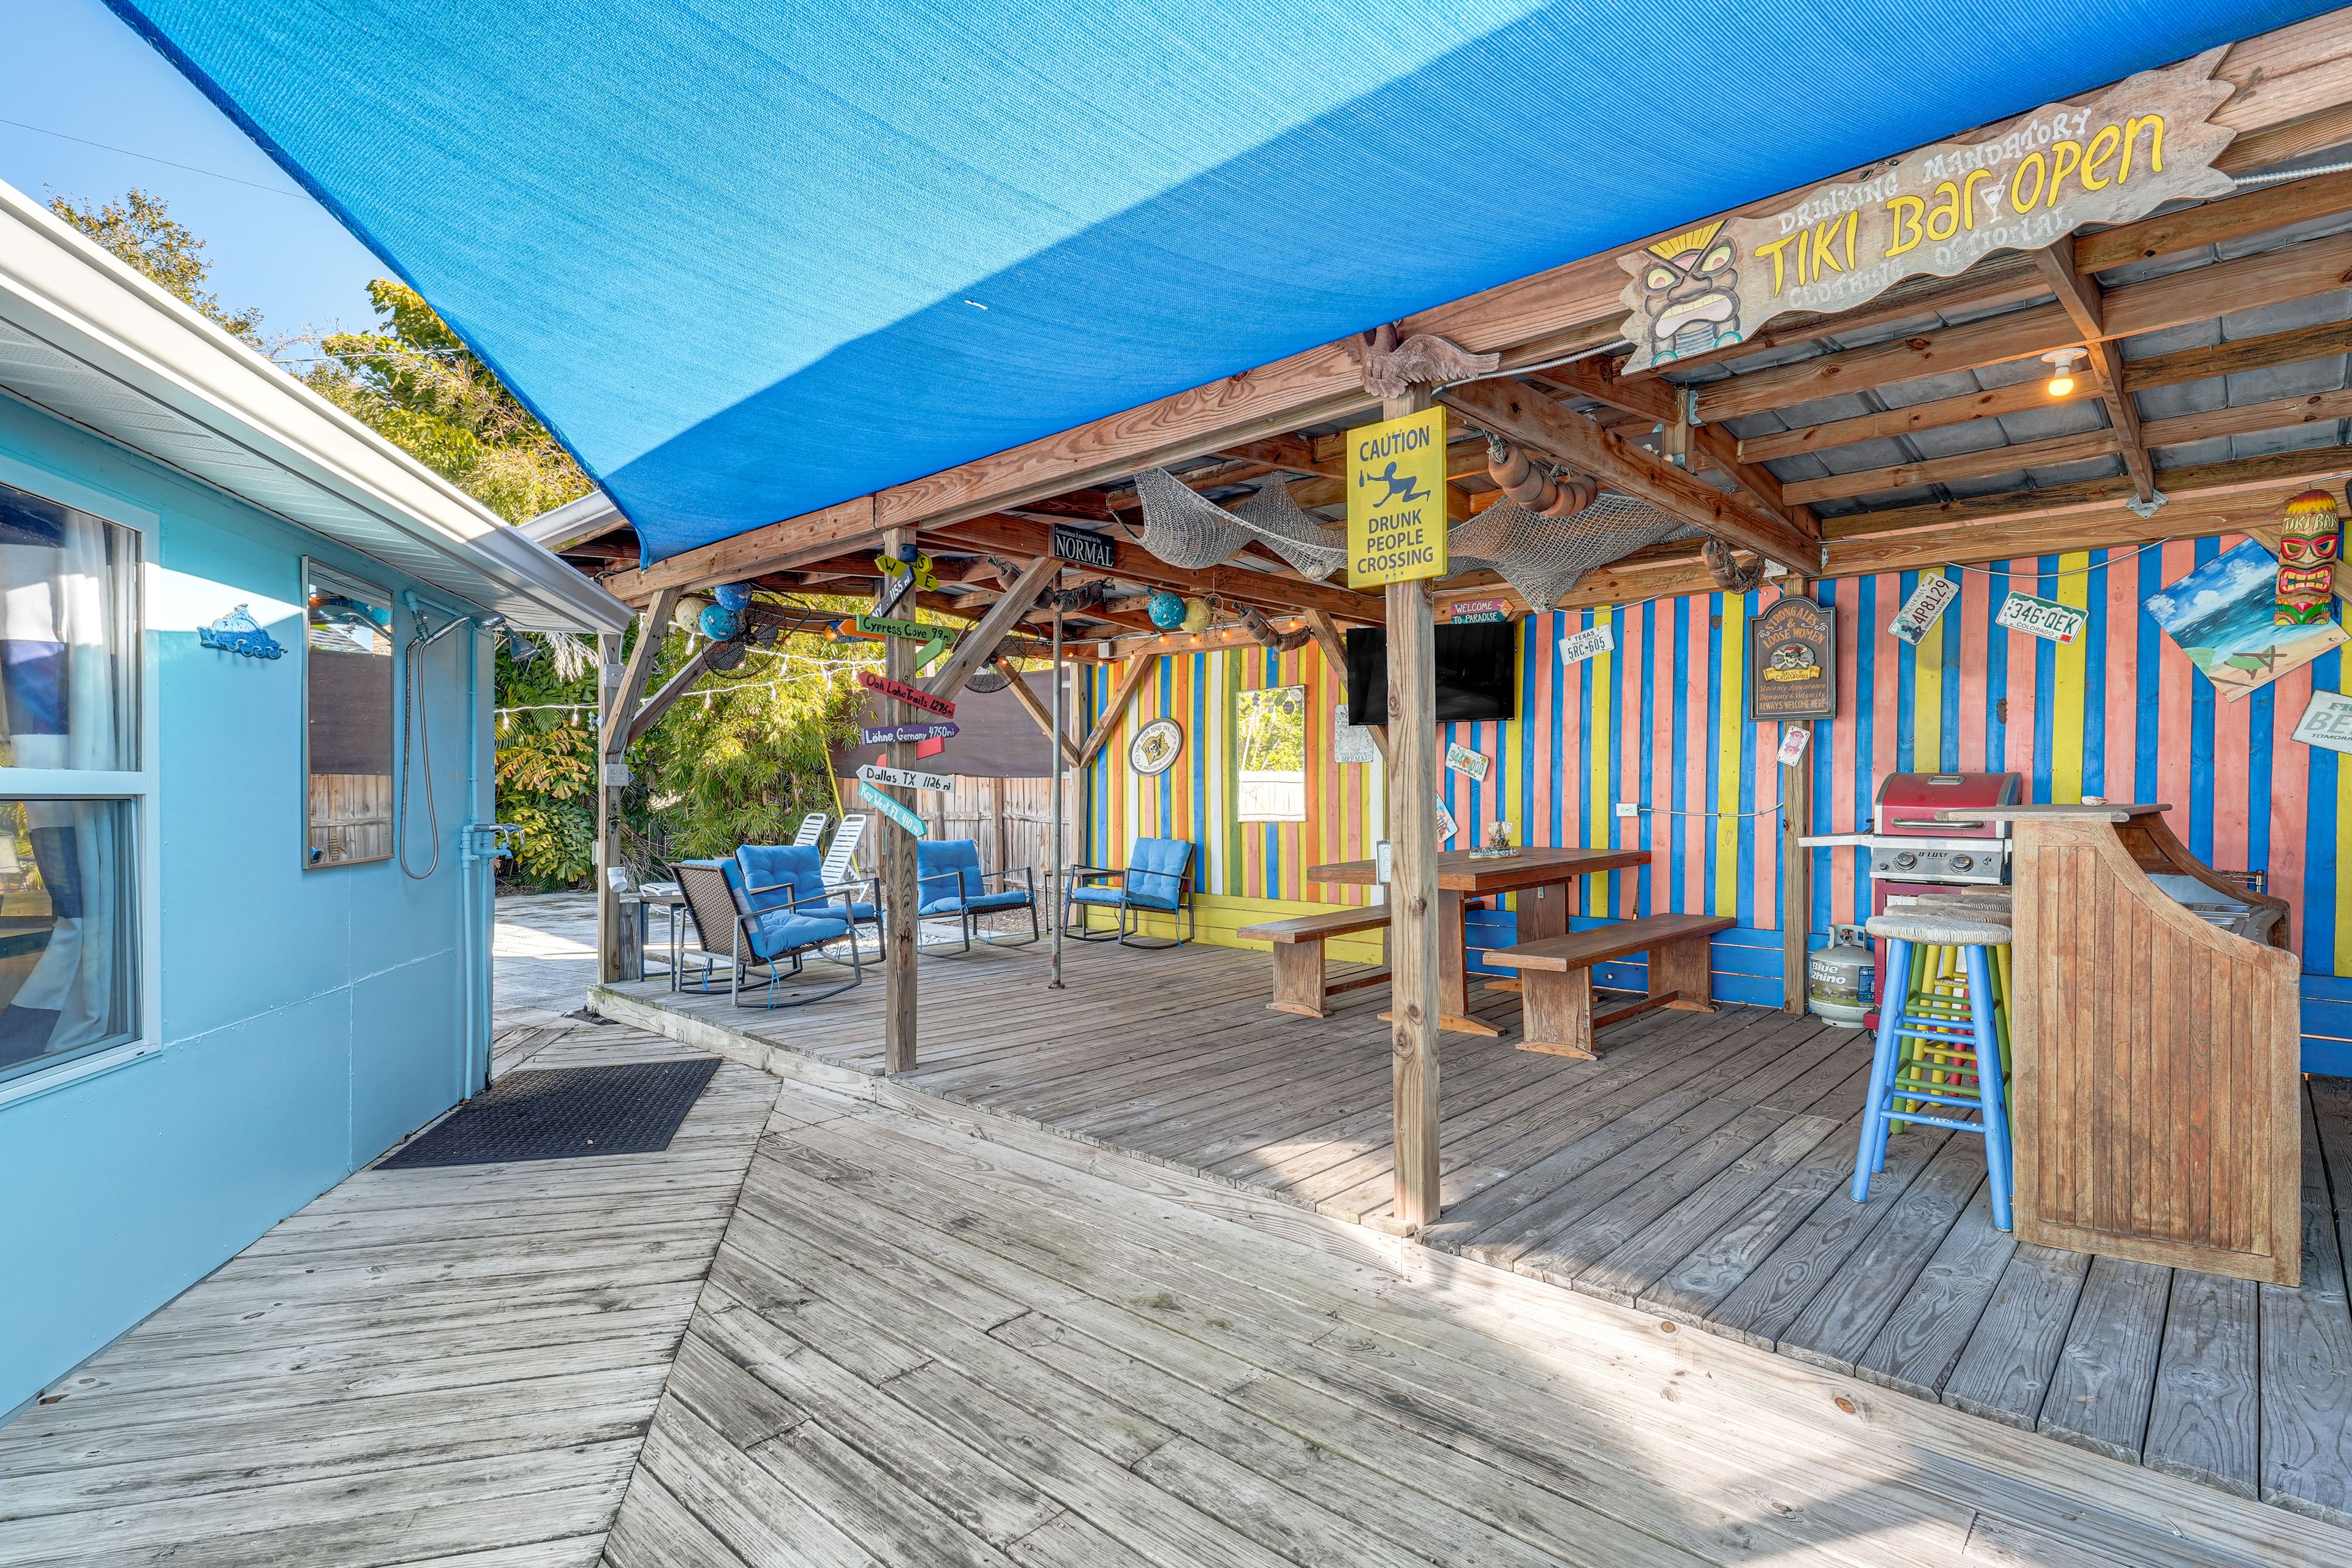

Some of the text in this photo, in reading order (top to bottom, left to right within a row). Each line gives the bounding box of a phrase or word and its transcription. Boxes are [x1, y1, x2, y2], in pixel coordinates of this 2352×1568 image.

[1778, 107, 2092, 235] DRINKING MANDATORY
[1754, 210, 1858, 299] TIKI
[1789, 206, 2073, 308] CLOTHING OPTIONAL
[1360, 425, 1429, 461] CAUTION
[1369, 508, 1422, 534] DRUNK
[2283, 513, 2337, 532] TIKI BAR
[1055, 527, 1076, 537] Sometimes
[1367, 529, 1423, 553] PEOPLE
[1055, 535, 1114, 567] NORMAL
[1357, 546, 1433, 574] CROSSING
[885, 558, 896, 572] W
[918, 557, 925, 569] S
[889, 579, 903, 601] 1155
[925, 576, 933, 588] E
[1455, 601, 1493, 613] WELCOME
[1901, 589, 1926, 619] OKLAHOMA
[1912, 580, 1949, 624] 4P8129
[863, 616, 902, 636] Cypress
[904, 624, 927, 638] Cove
[1453, 612, 1498, 624] TO PARADISE
[1765, 606, 1819, 631] STRONG ALES
[1787, 618, 1796, 628] &
[1574, 630, 1595, 641] TEXAS
[1762, 628, 1825, 649] LOOSE WOMEN
[2016, 622, 2054, 636] COLORADO
[866, 674, 884, 690] Oak
[887, 682, 906, 698] Lake
[907, 688, 927, 707] Trails
[1759, 699, 1825, 710] ALWAYS WELCOME HERE
[2304, 712, 2352, 734] BE
[897, 728, 927, 741] Germany
[1140, 730, 1150, 742] BLACK
[903, 772, 916, 786] TX
[923, 776, 941, 789] 1126
[861, 785, 873, 802] Key
[890, 805, 899, 820] FL
[902, 813, 913, 827] 410
[1811, 971, 1846, 984] Rhino
[1812, 962, 1839, 974] Blue
